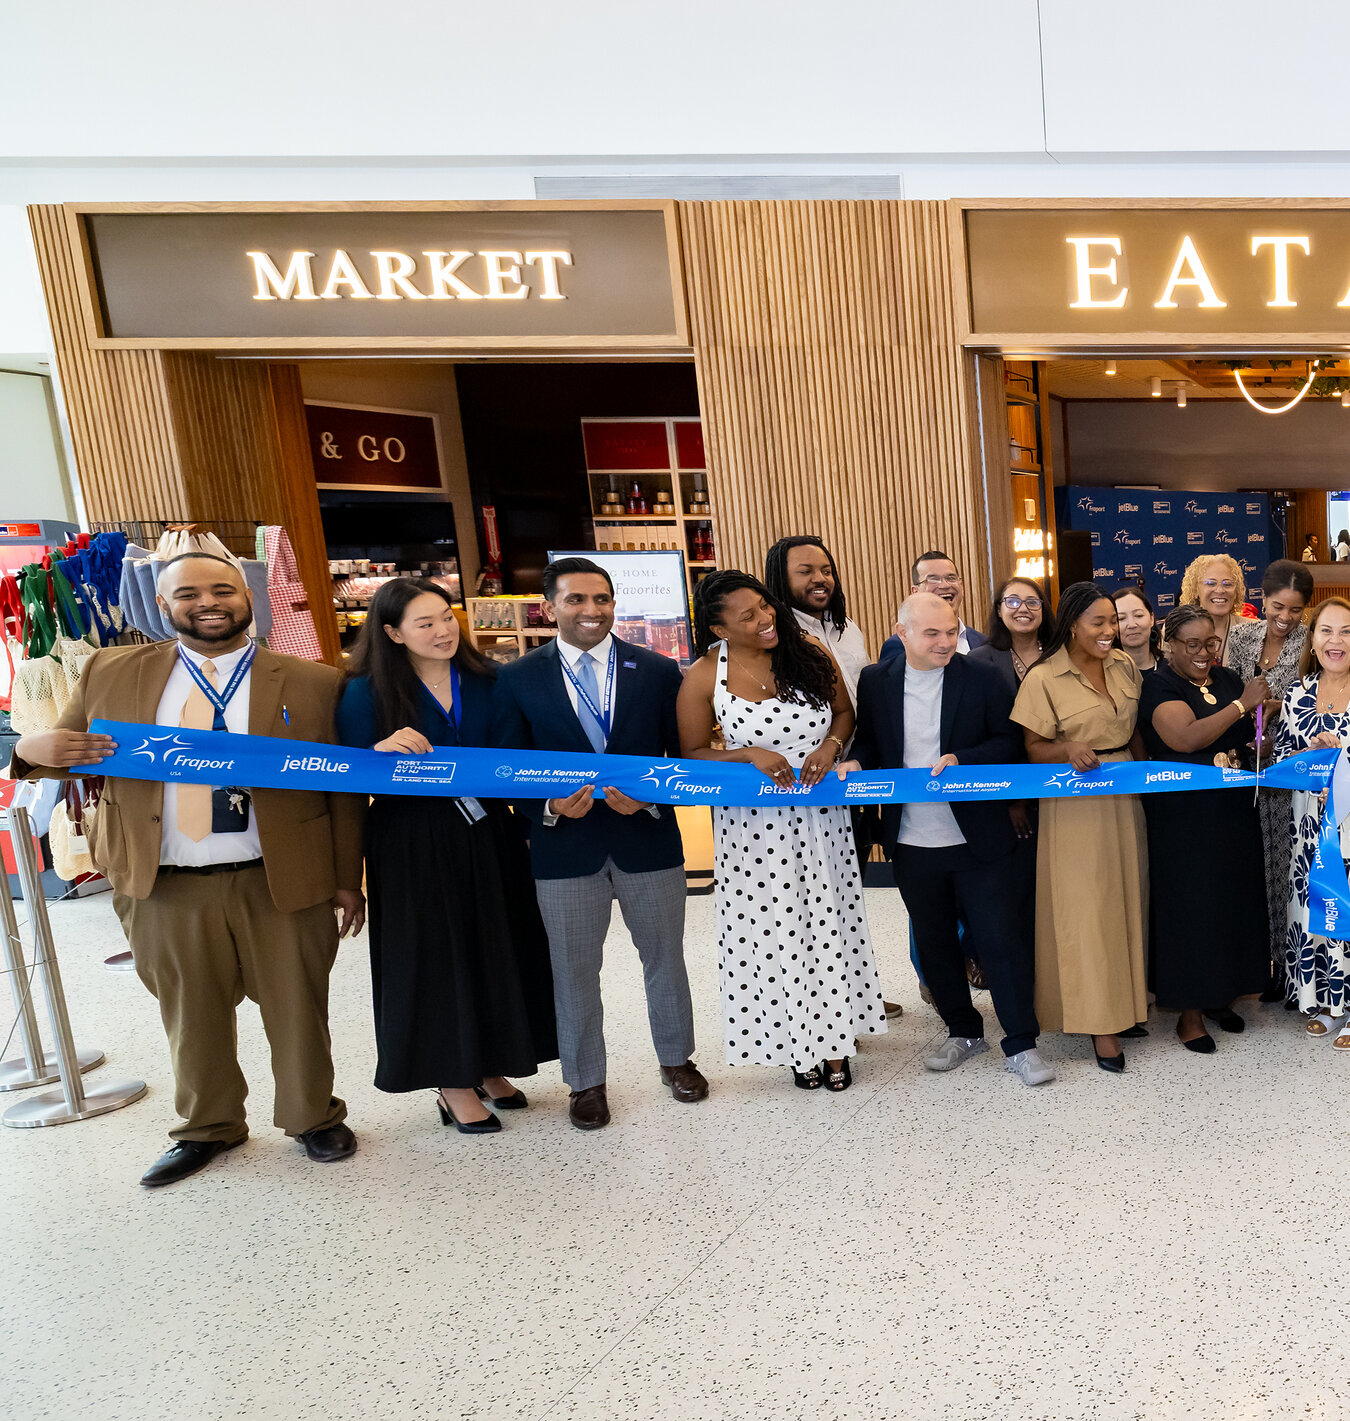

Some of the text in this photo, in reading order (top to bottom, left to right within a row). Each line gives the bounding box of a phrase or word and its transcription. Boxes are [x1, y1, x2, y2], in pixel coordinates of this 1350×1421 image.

[245, 249, 573, 301] MARKET
[320, 431, 406, 463] & GO
[616, 582, 671, 595] Favorites
[173, 755, 235, 771] Fraport
[281, 755, 350, 773] jetBlue
[1309, 763, 1335, 771] John F
[552, 769, 599, 779] Kennedy
[1145, 770, 1192, 784] jetBlue
[674, 780, 722, 795] Fraport
[1073, 779, 1114, 790] Fraport
[1322, 897, 1339, 931] jetBlue
